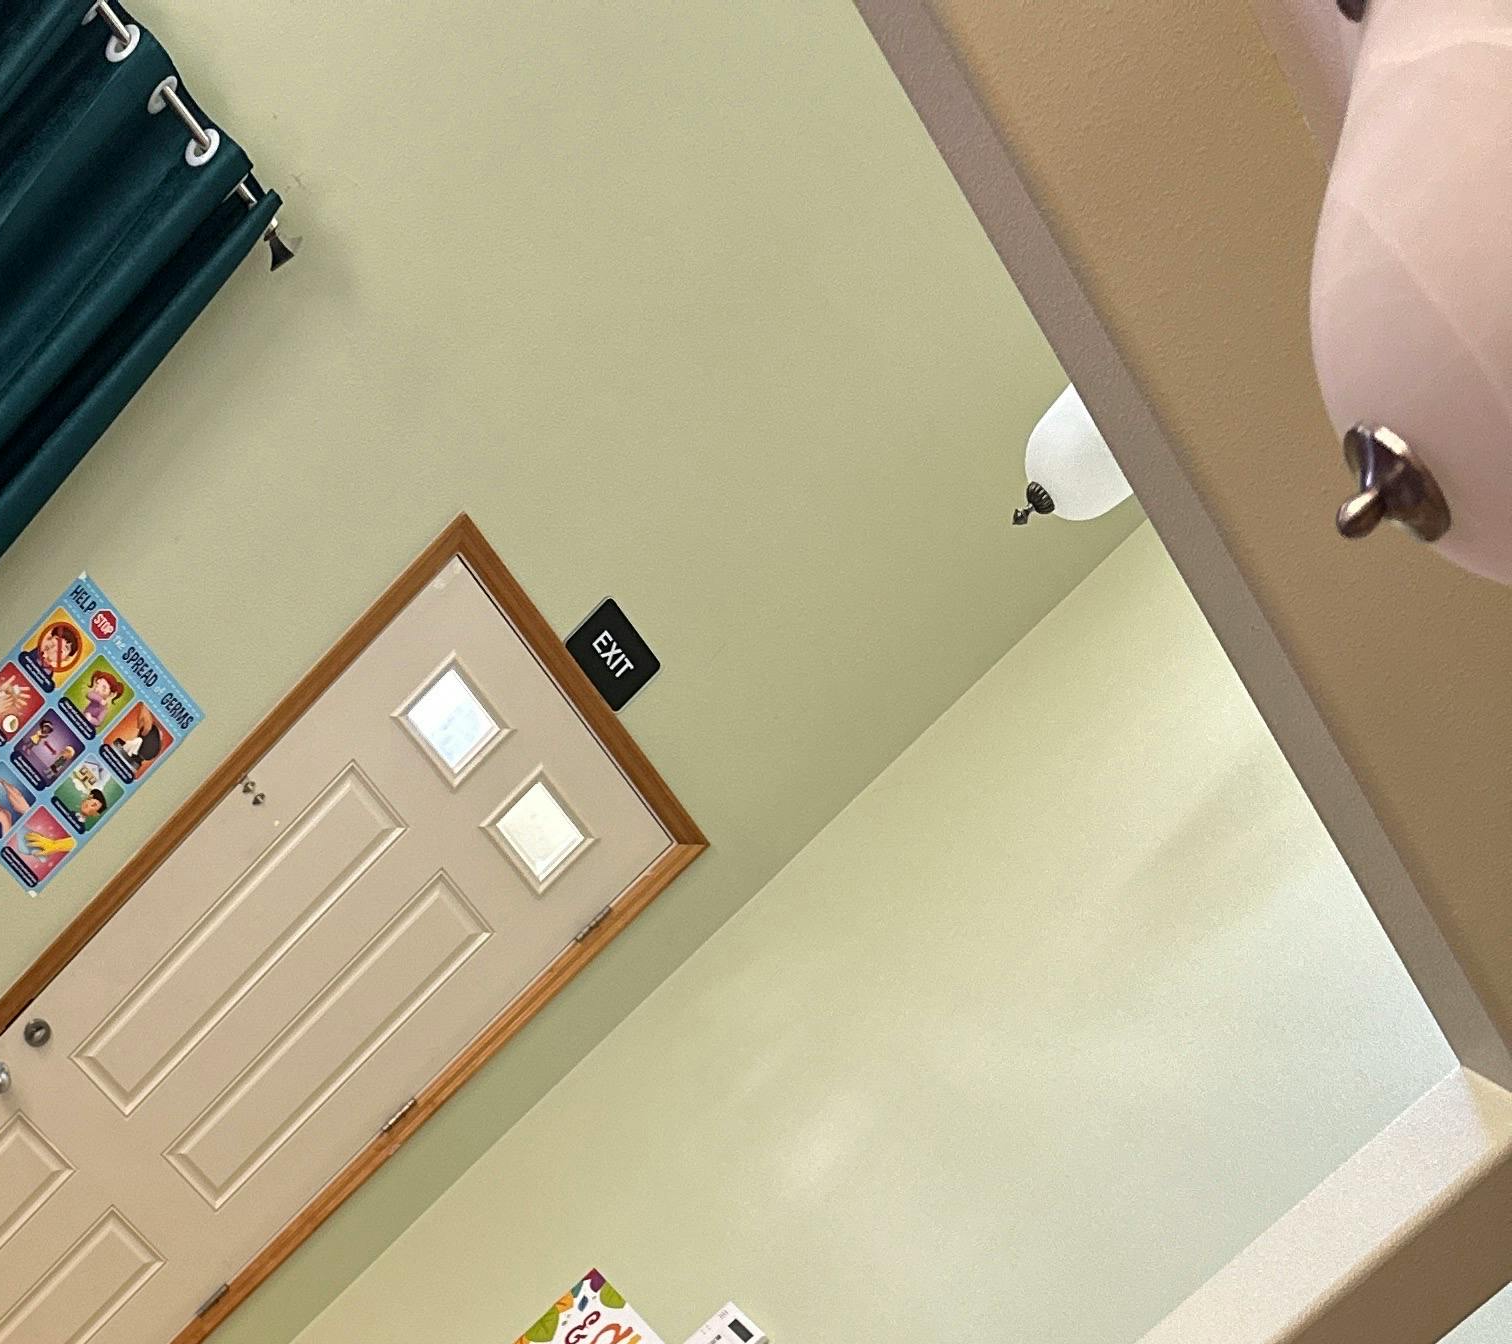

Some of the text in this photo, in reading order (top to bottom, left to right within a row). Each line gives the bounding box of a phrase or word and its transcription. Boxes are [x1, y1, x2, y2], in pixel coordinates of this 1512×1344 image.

[70, 585, 96, 613] HELP
[94, 614, 114, 635] STOP
[122, 647, 158, 688] SPREAD
[161, 693, 194, 730] GERMS
[592, 630, 635, 678] EXIT
